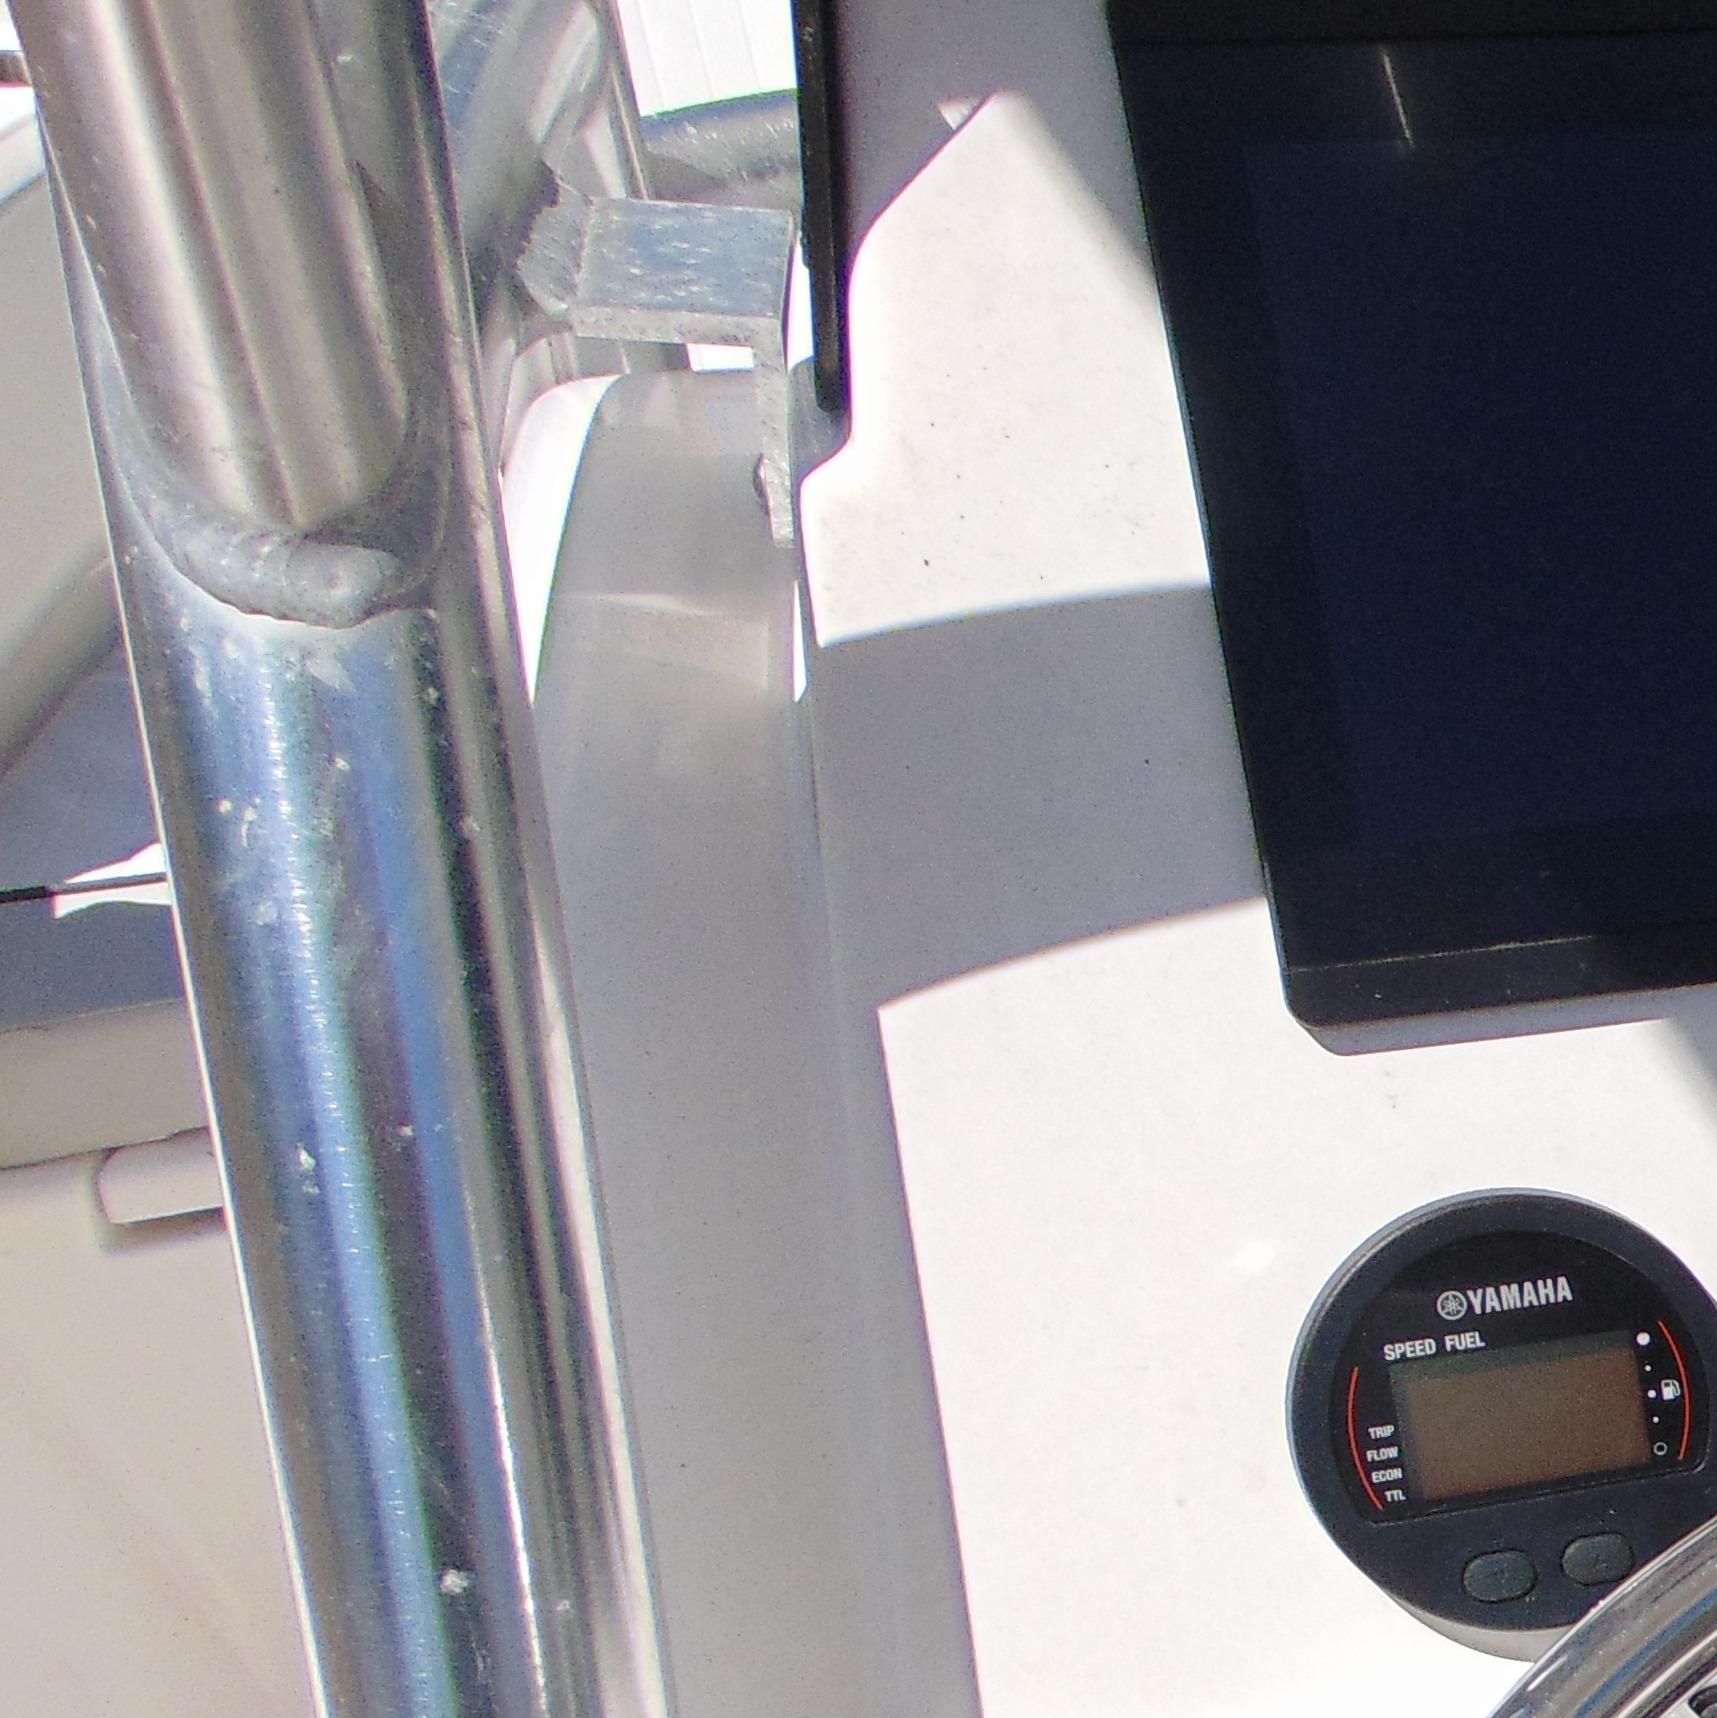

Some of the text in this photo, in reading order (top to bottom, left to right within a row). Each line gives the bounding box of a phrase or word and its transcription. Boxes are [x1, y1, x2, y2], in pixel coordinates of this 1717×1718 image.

[1467, 1276, 1573, 1315] YAMAHA
[1384, 1331, 1486, 1361] SPEED FUEL
[1368, 1424, 1394, 1439] TRIP
[1366, 1446, 1399, 1462] FLOW
[1371, 1468, 1402, 1483] ECON
[1385, 1489, 1406, 1502] TTL
